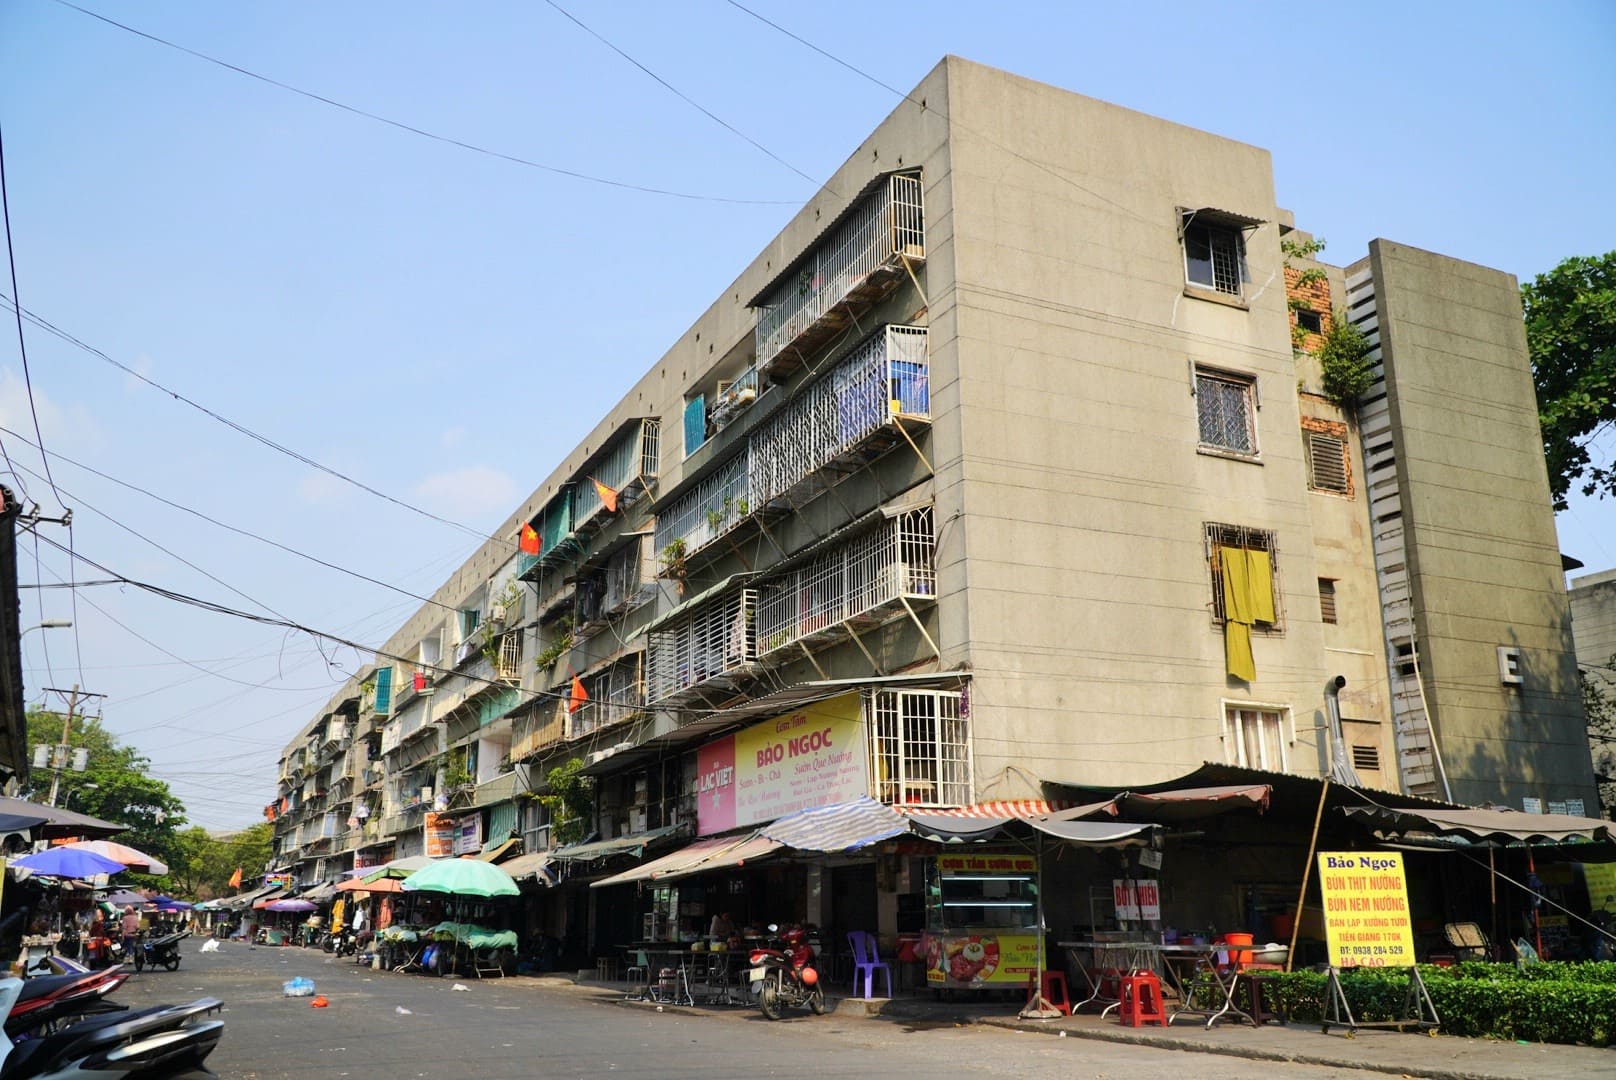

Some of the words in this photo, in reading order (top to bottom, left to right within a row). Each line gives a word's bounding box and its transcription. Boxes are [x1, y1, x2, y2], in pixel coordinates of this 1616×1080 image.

[1497, 647, 1524, 683] E
[756, 742, 784, 768] BẢO
[788, 727, 832, 758] NGỌC
[1327, 856, 1354, 868] Bảo
[1359, 857, 1396, 871] Ngọc
[1326, 873, 1345, 890] BÚN
[1348, 876, 1366, 893] THỊT
[1369, 873, 1402, 890] NƯỚNG
[1328, 894, 1347, 911] BÚN
[1349, 897, 1370, 911] NEM
[1373, 894, 1405, 911] NƯỚNG
[1357, 933, 1380, 942] GIANG
[1340, 946, 1351, 954] ĐT:
[1353, 946, 1371, 954] 0938
[1389, 946, 1403, 954] 529
